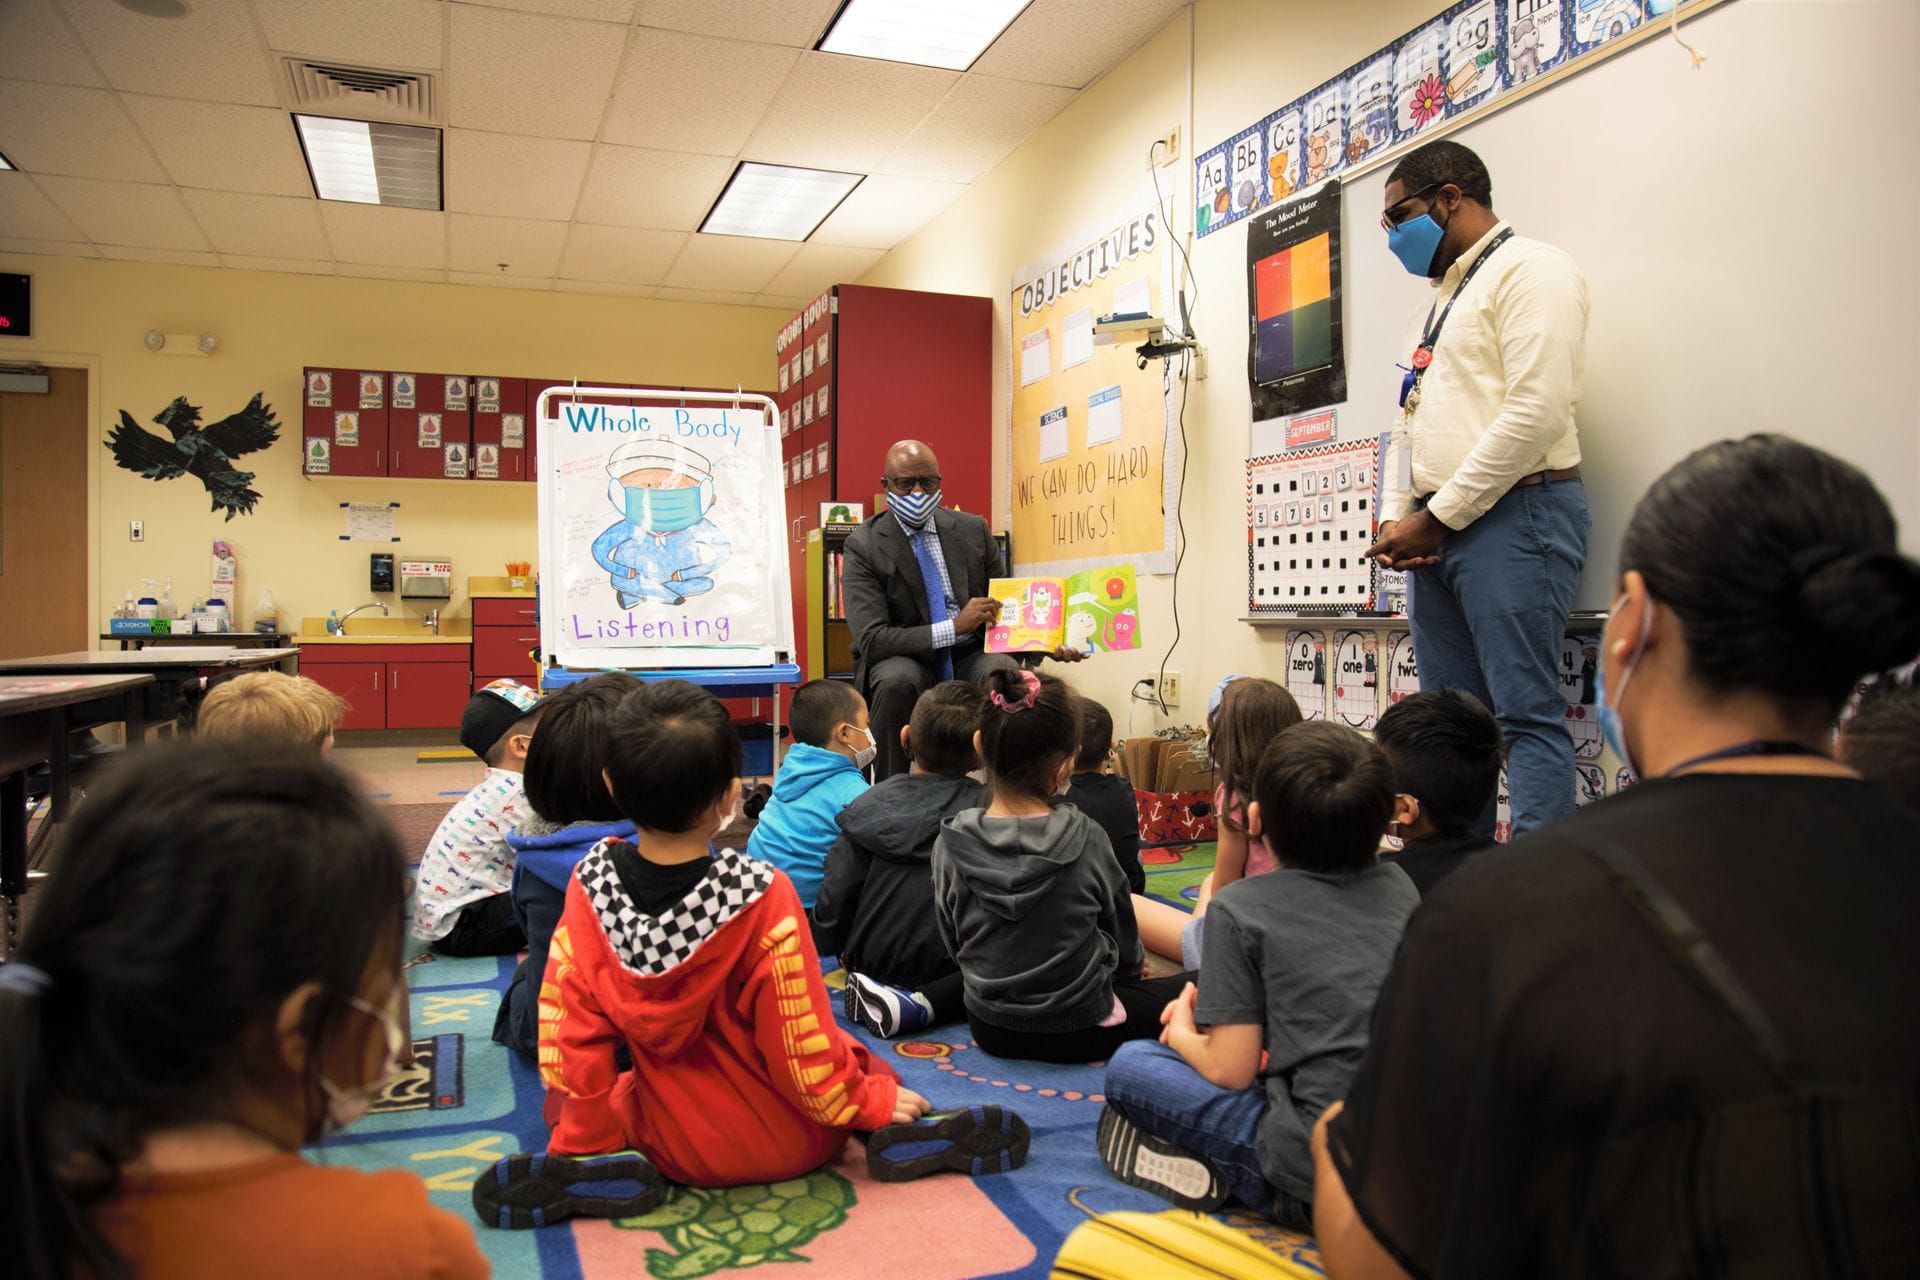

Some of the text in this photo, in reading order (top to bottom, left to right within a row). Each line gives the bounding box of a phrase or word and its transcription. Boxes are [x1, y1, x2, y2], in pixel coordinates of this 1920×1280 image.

[1537, 10, 1559, 26] hippo
[1578, 13, 1592, 25] ice
[1457, 16, 1489, 50] Gg
[1463, 84, 1479, 99] gum
[1313, 91, 1337, 132] Dd
[1273, 123, 1296, 151] Cc
[1237, 140, 1258, 172] Bb
[1203, 165, 1222, 191] Aa
[1265, 199, 1319, 230] The Mood Meter
[1021, 211, 1156, 315] OBJECTIVES
[396, 399, 412, 407] blue
[446, 402, 466, 410] purple
[479, 404, 497, 412] gray
[1044, 407, 1065, 424] SCIENCE
[565, 405, 742, 447] Whole Body
[1289, 420, 1331, 439] SEPTEMBER
[307, 464, 329, 472] green
[446, 468, 465, 476] black
[1017, 445, 1148, 509] WE CAN DO HARD
[1306, 471, 1365, 491] 1 2 3 4
[1051, 495, 1115, 546] THINGS!
[1258, 503, 1329, 523] 5 6 7 8 9
[572, 611, 731, 642] Listening
[1301, 643, 1309, 659] 0
[1407, 646, 1415, 663] 2
[1563, 650, 1574, 671] 4
[1292, 659, 1314, 672] zero
[1343, 661, 1362, 673] one
[1397, 662, 1418, 678] two
